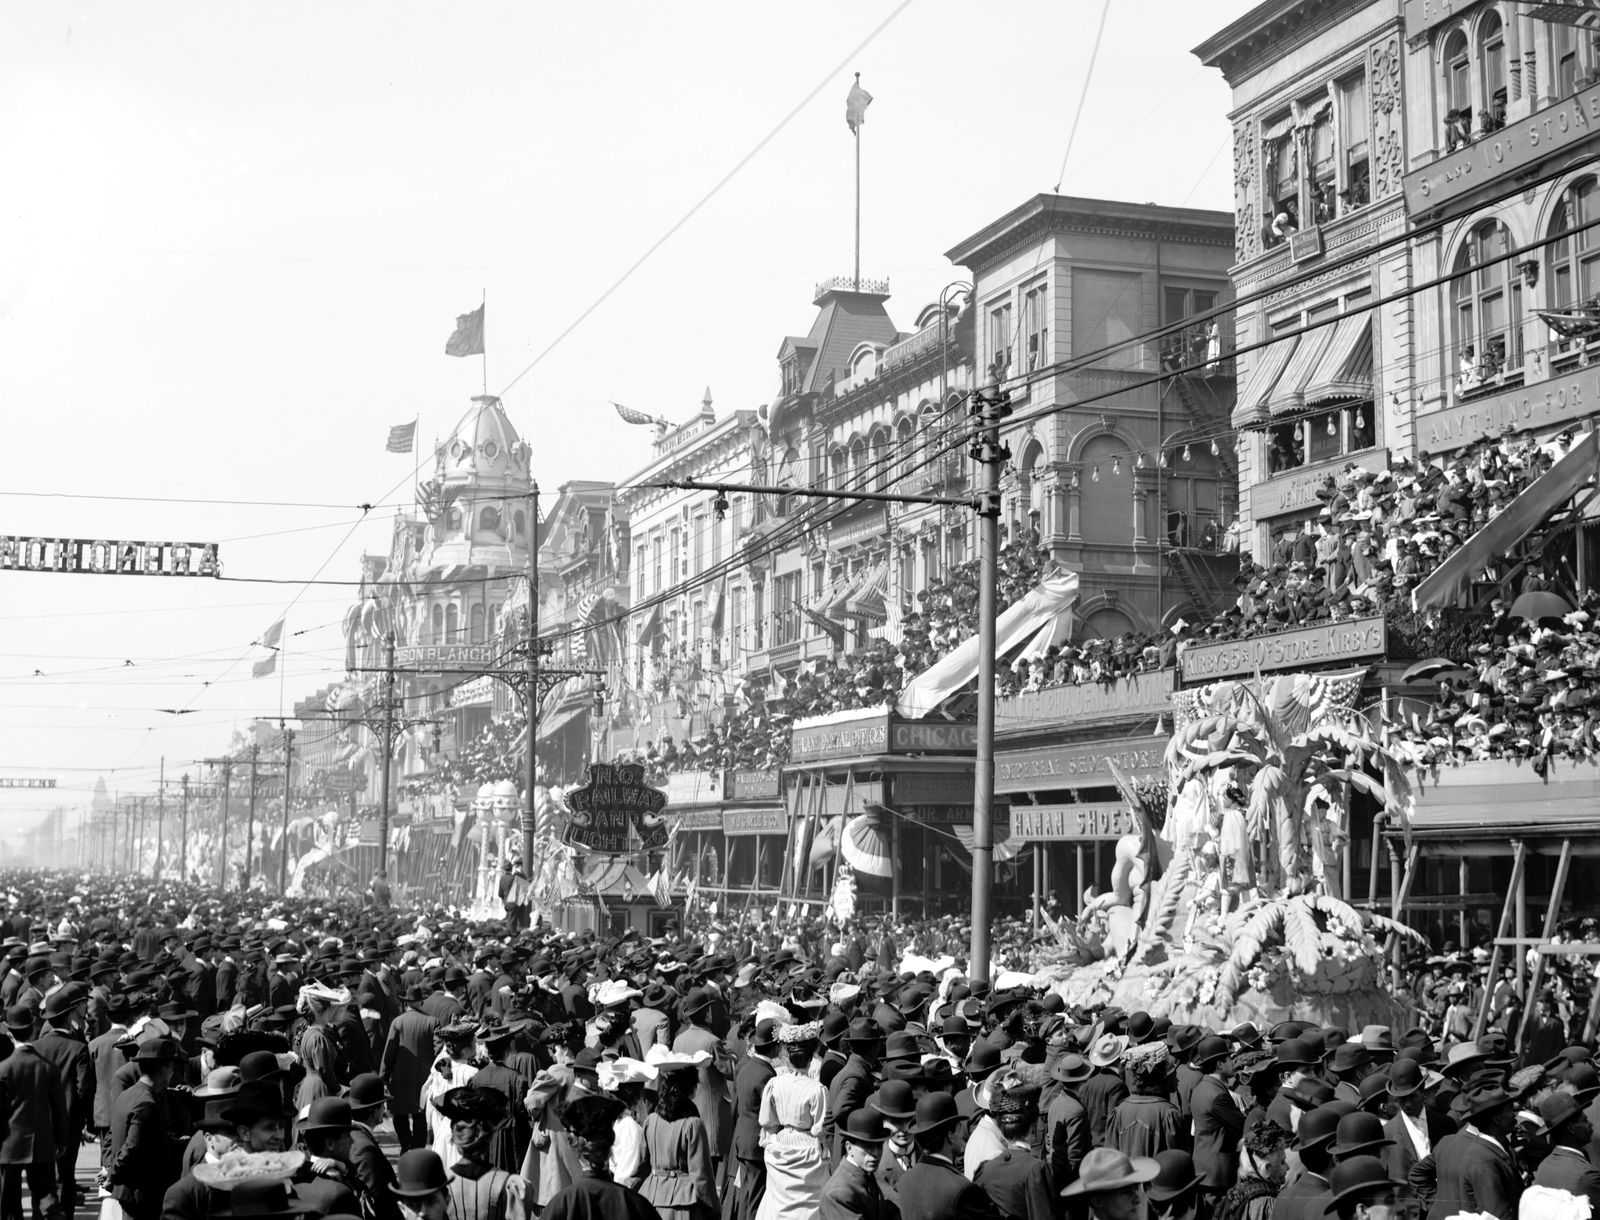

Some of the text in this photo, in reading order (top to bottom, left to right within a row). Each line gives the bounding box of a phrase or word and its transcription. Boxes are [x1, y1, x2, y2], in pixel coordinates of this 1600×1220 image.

[1420, 175, 1431, 197] 5
[1445, 161, 1472, 183] AND
[1529, 95, 1600, 147] STORE
[1431, 399, 1532, 444] ANYTHING
[1544, 383, 1583, 415] FOR
[1280, 486, 1317, 510] DENTAL
[90, 539, 219, 576] OPERA
[427, 647, 491, 661] BLANCH
[1186, 648, 1230, 676] KIRBY'S
[1231, 646, 1241, 670] 5
[1325, 624, 1381, 656] KIRBY'S
[896, 726, 978, 747] CHICAG
[1002, 759, 1063, 780] IMPERIAL
[1069, 754, 1105, 774] SHOE
[575, 786, 661, 810] RAILWAY
[594, 810, 639, 827] AND
[1015, 809, 1134, 836] HANAN SHOES
